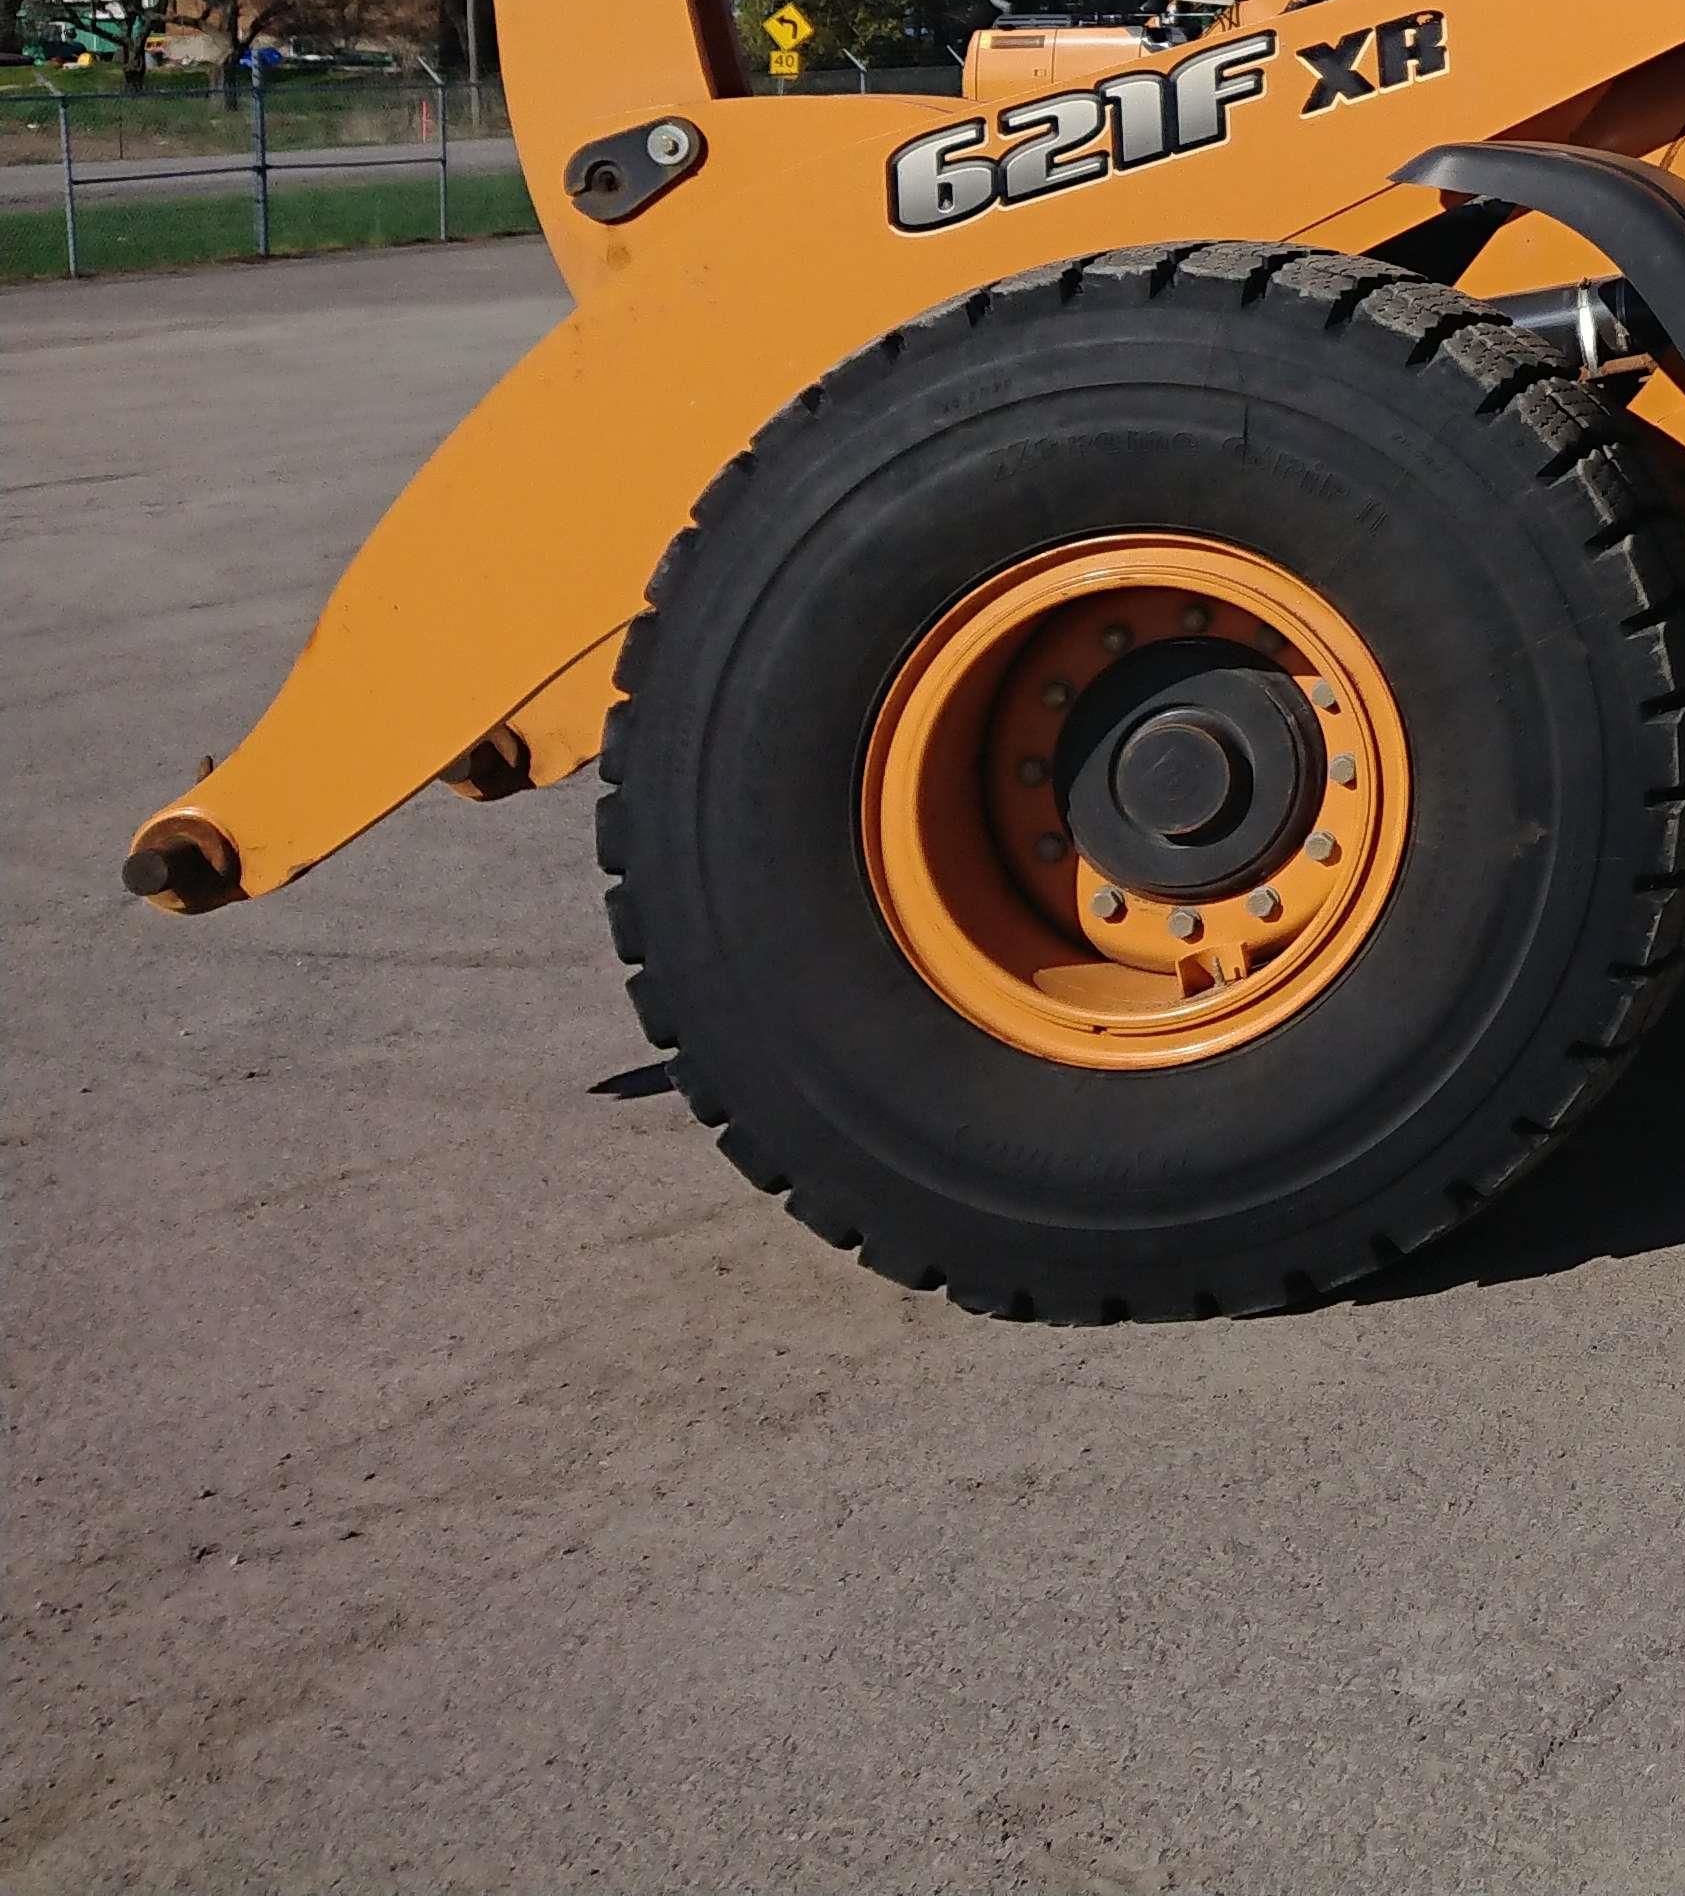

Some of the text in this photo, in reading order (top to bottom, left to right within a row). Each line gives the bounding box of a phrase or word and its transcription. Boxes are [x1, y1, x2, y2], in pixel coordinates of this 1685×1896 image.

[773, 54, 795, 68] 40
[887, 10, 1449, 232] 621F XR
